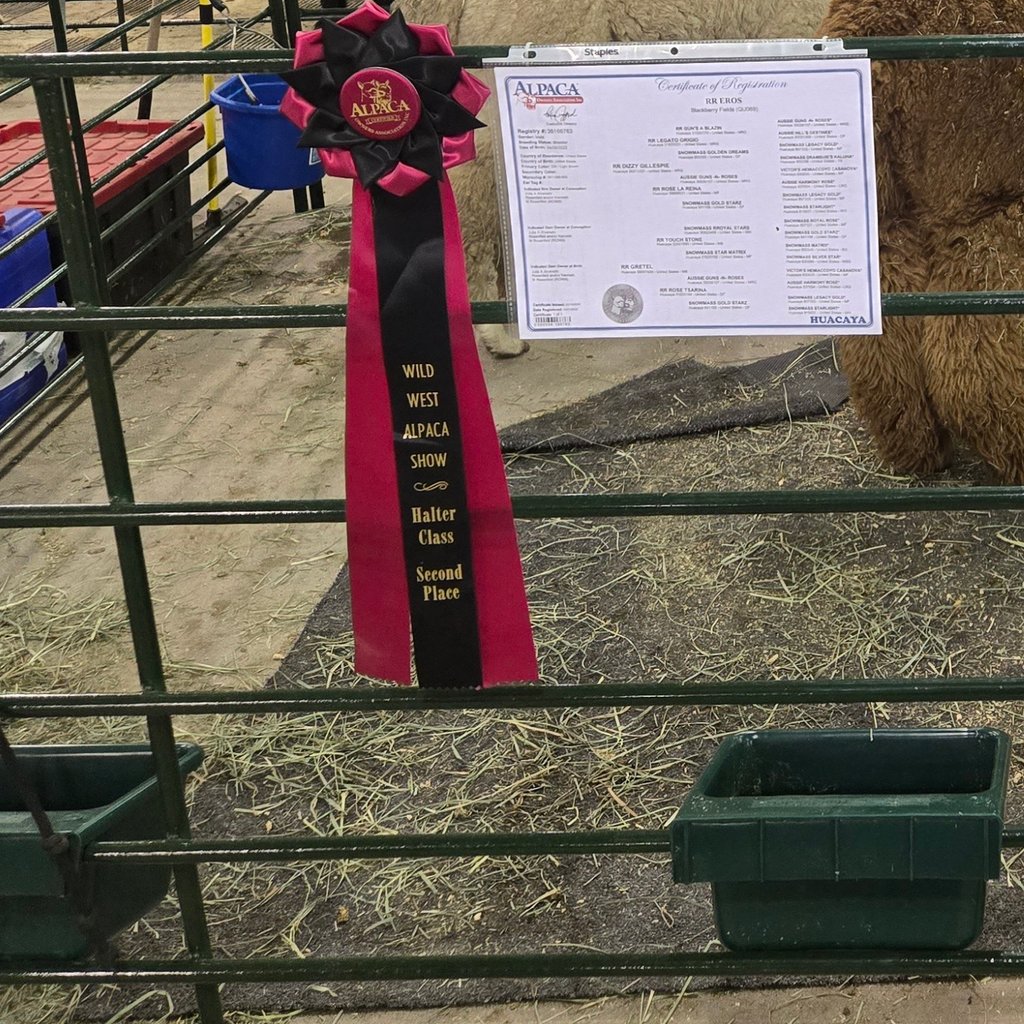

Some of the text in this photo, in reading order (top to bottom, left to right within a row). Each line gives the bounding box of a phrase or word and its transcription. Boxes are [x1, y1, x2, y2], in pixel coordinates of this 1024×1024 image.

[584, 48, 619, 57] Staples
[513, 80, 581, 96] ALPACA
[655, 76, 787, 95] Certificate of Registration
[350, 100, 411, 118] ALPACA
[810, 316, 866, 324] HUACAYA
[402, 364, 434, 379] WILD
[407, 392, 438, 408] WEST
[403, 422, 450, 439] ALPACA
[410, 453, 447, 469] SHOW
[412, 506, 456, 524] Halter
[419, 529, 454, 545] Class
[416, 564, 463, 582] Second
[423, 586, 460, 601] Place
